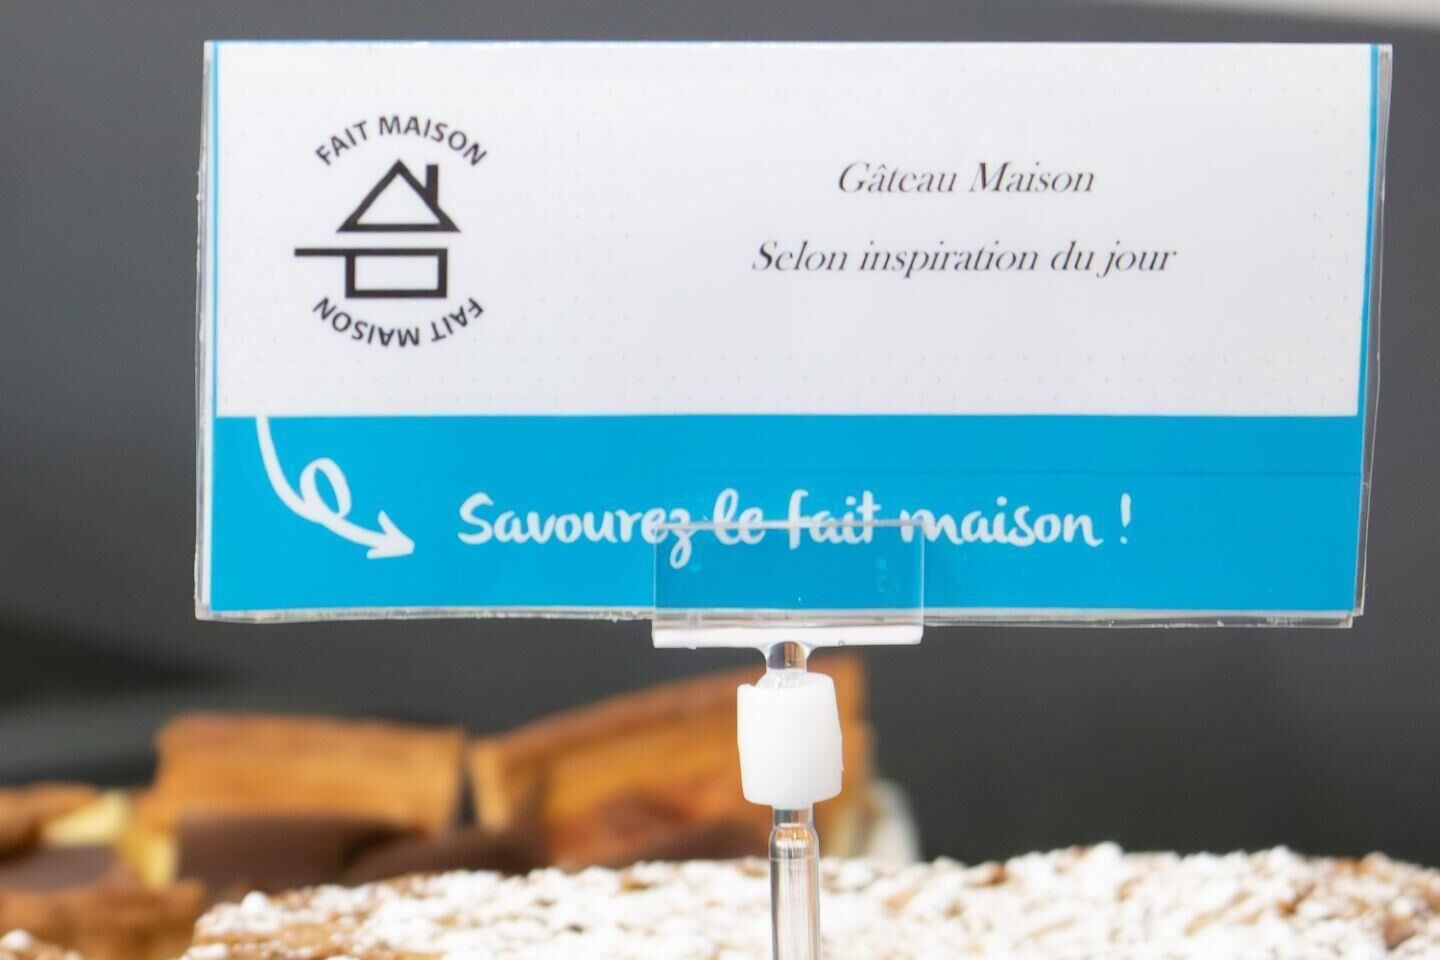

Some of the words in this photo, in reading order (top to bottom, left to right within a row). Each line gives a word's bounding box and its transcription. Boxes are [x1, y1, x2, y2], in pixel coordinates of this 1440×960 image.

[315, 120, 369, 166] FAIT
[378, 115, 487, 167] MAISON
[837, 160, 959, 194] Gâteau
[968, 161, 1096, 194] Maison
[752, 240, 849, 272] Selon
[859, 240, 1039, 280] inspiration
[1049, 240, 1096, 272] du
[1095, 240, 1178, 280] jour
[313, 297, 419, 347] MAISON
[431, 298, 484, 342] FAIT
[458, 492, 694, 569] Savourez
[713, 487, 767, 546] le
[788, 490, 882, 551] fait
[898, 497, 1103, 548] maison
